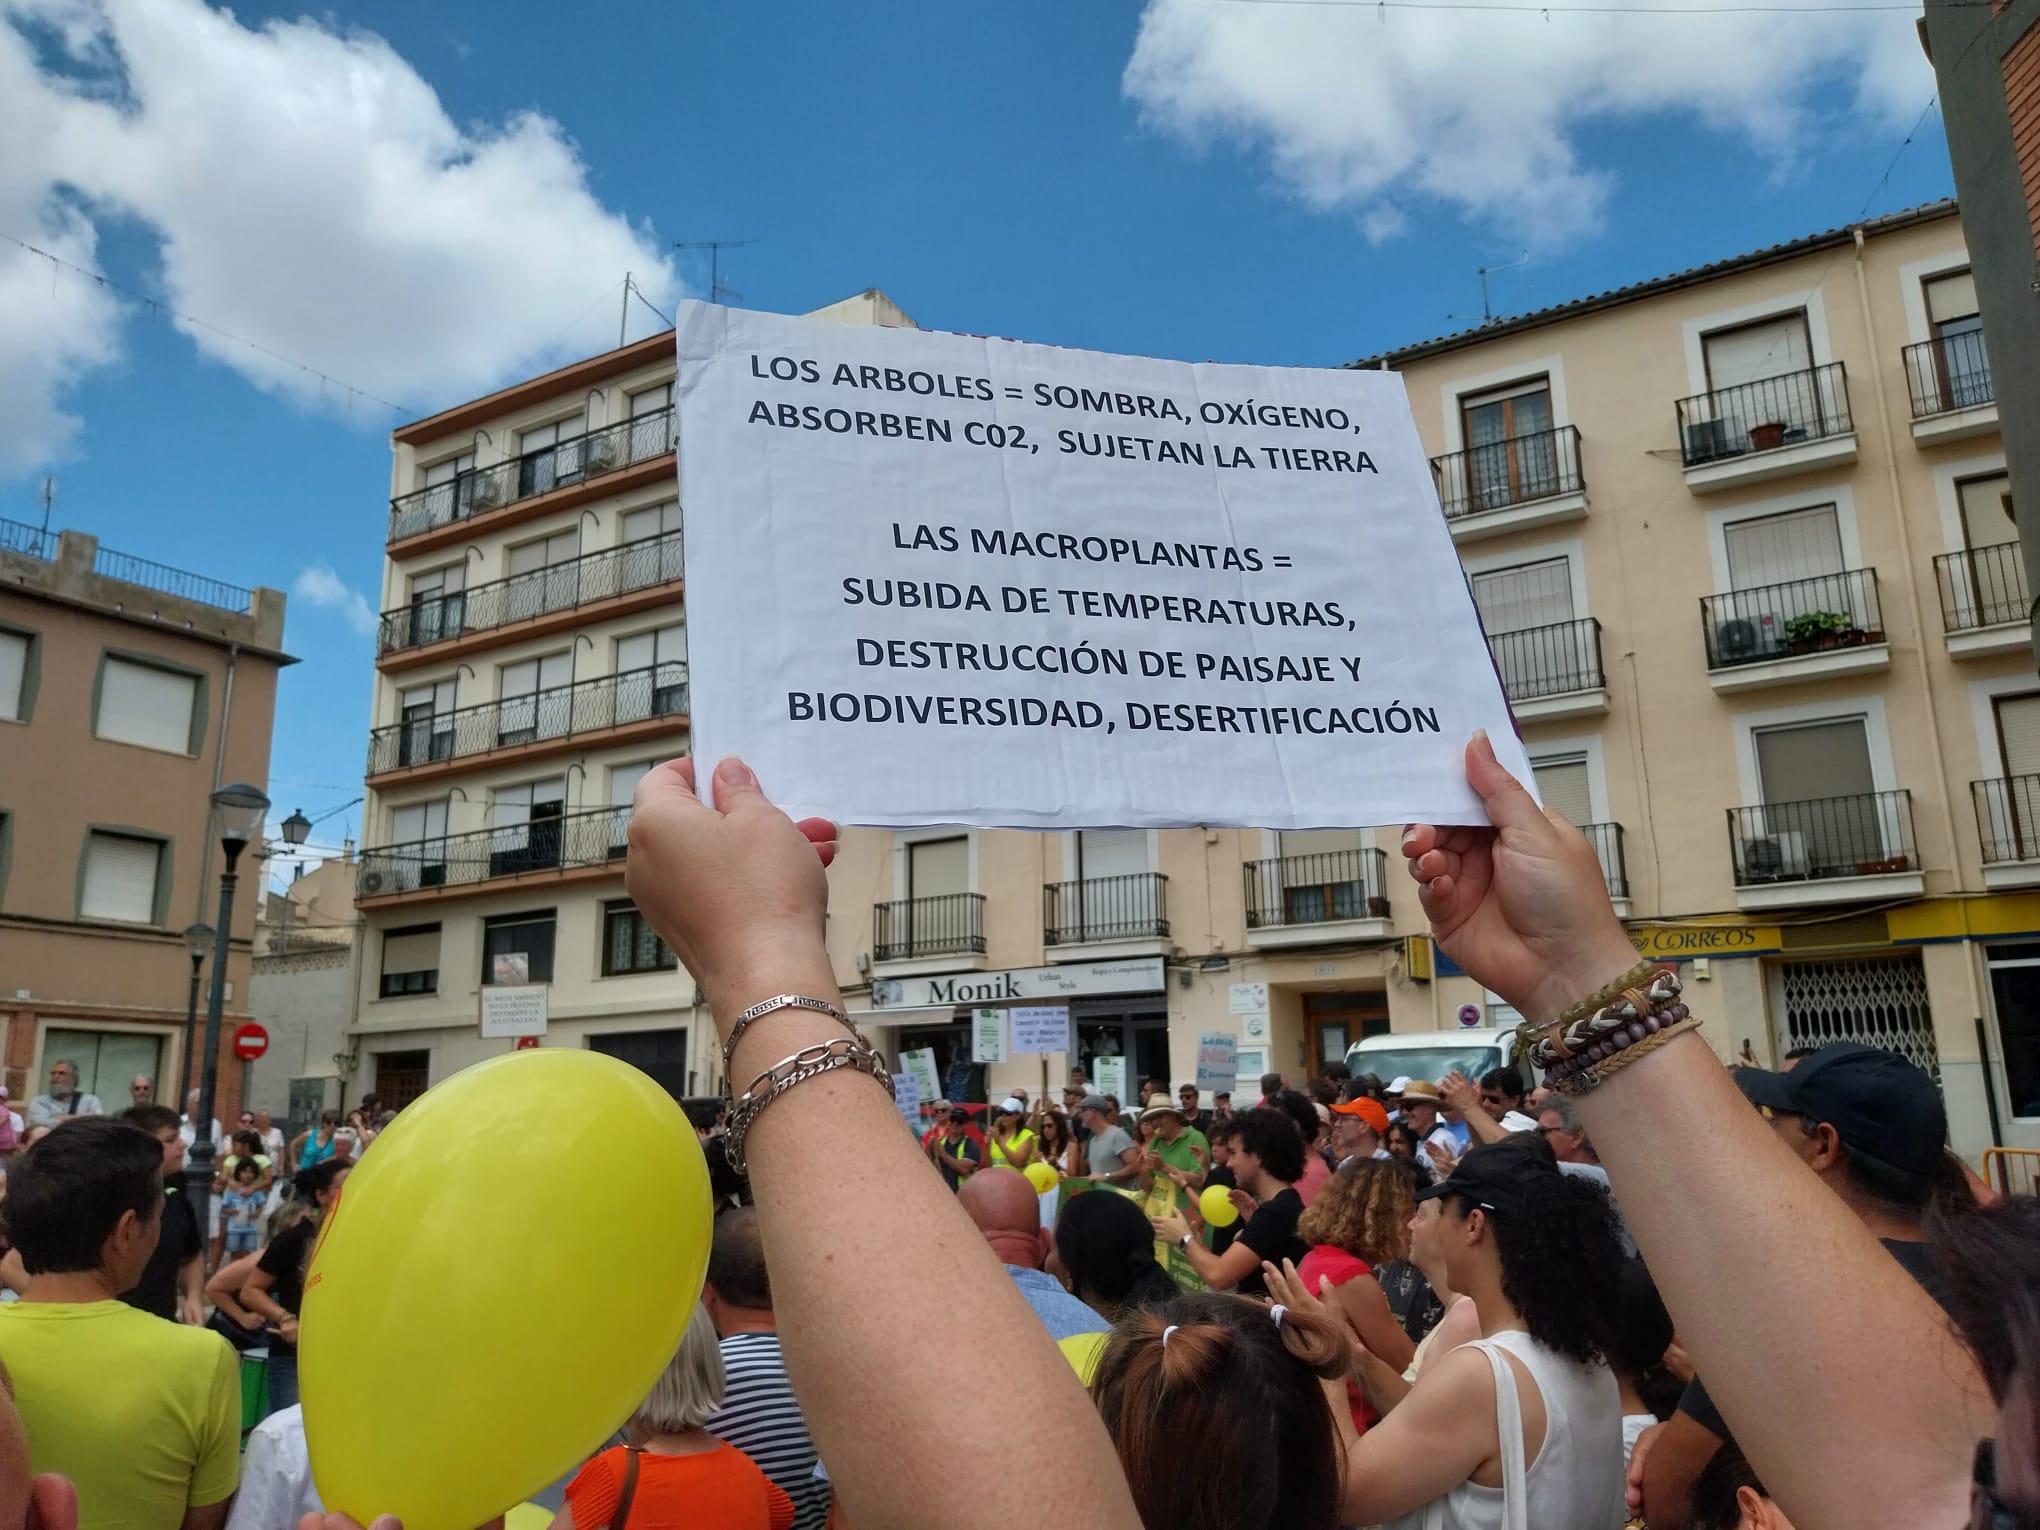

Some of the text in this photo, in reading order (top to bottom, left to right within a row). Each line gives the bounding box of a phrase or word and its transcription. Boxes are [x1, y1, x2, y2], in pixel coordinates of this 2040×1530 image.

[751, 354, 1361, 435] LOS ARBOLES = SOMBRA, OXÍGENO,
[748, 400, 952, 443] ABSORBEN
[1057, 429, 1205, 467] SUJETAN
[1213, 445, 1256, 469] LA
[1260, 447, 1379, 474] TIERRA
[892, 522, 1293, 572] LAS MACROPLANTAS =
[842, 577, 1356, 632] SUBIDA DE TEMPERATURAS,
[856, 638, 1361, 683] DESTRUCCIÓN DE PAISAJE Y
[788, 692, 1441, 735] BIODIVERSIDAD, DESERTIFICACIÓN
[1653, 927, 1756, 951] CORREOS
[928, 972, 1022, 1004] Monik
